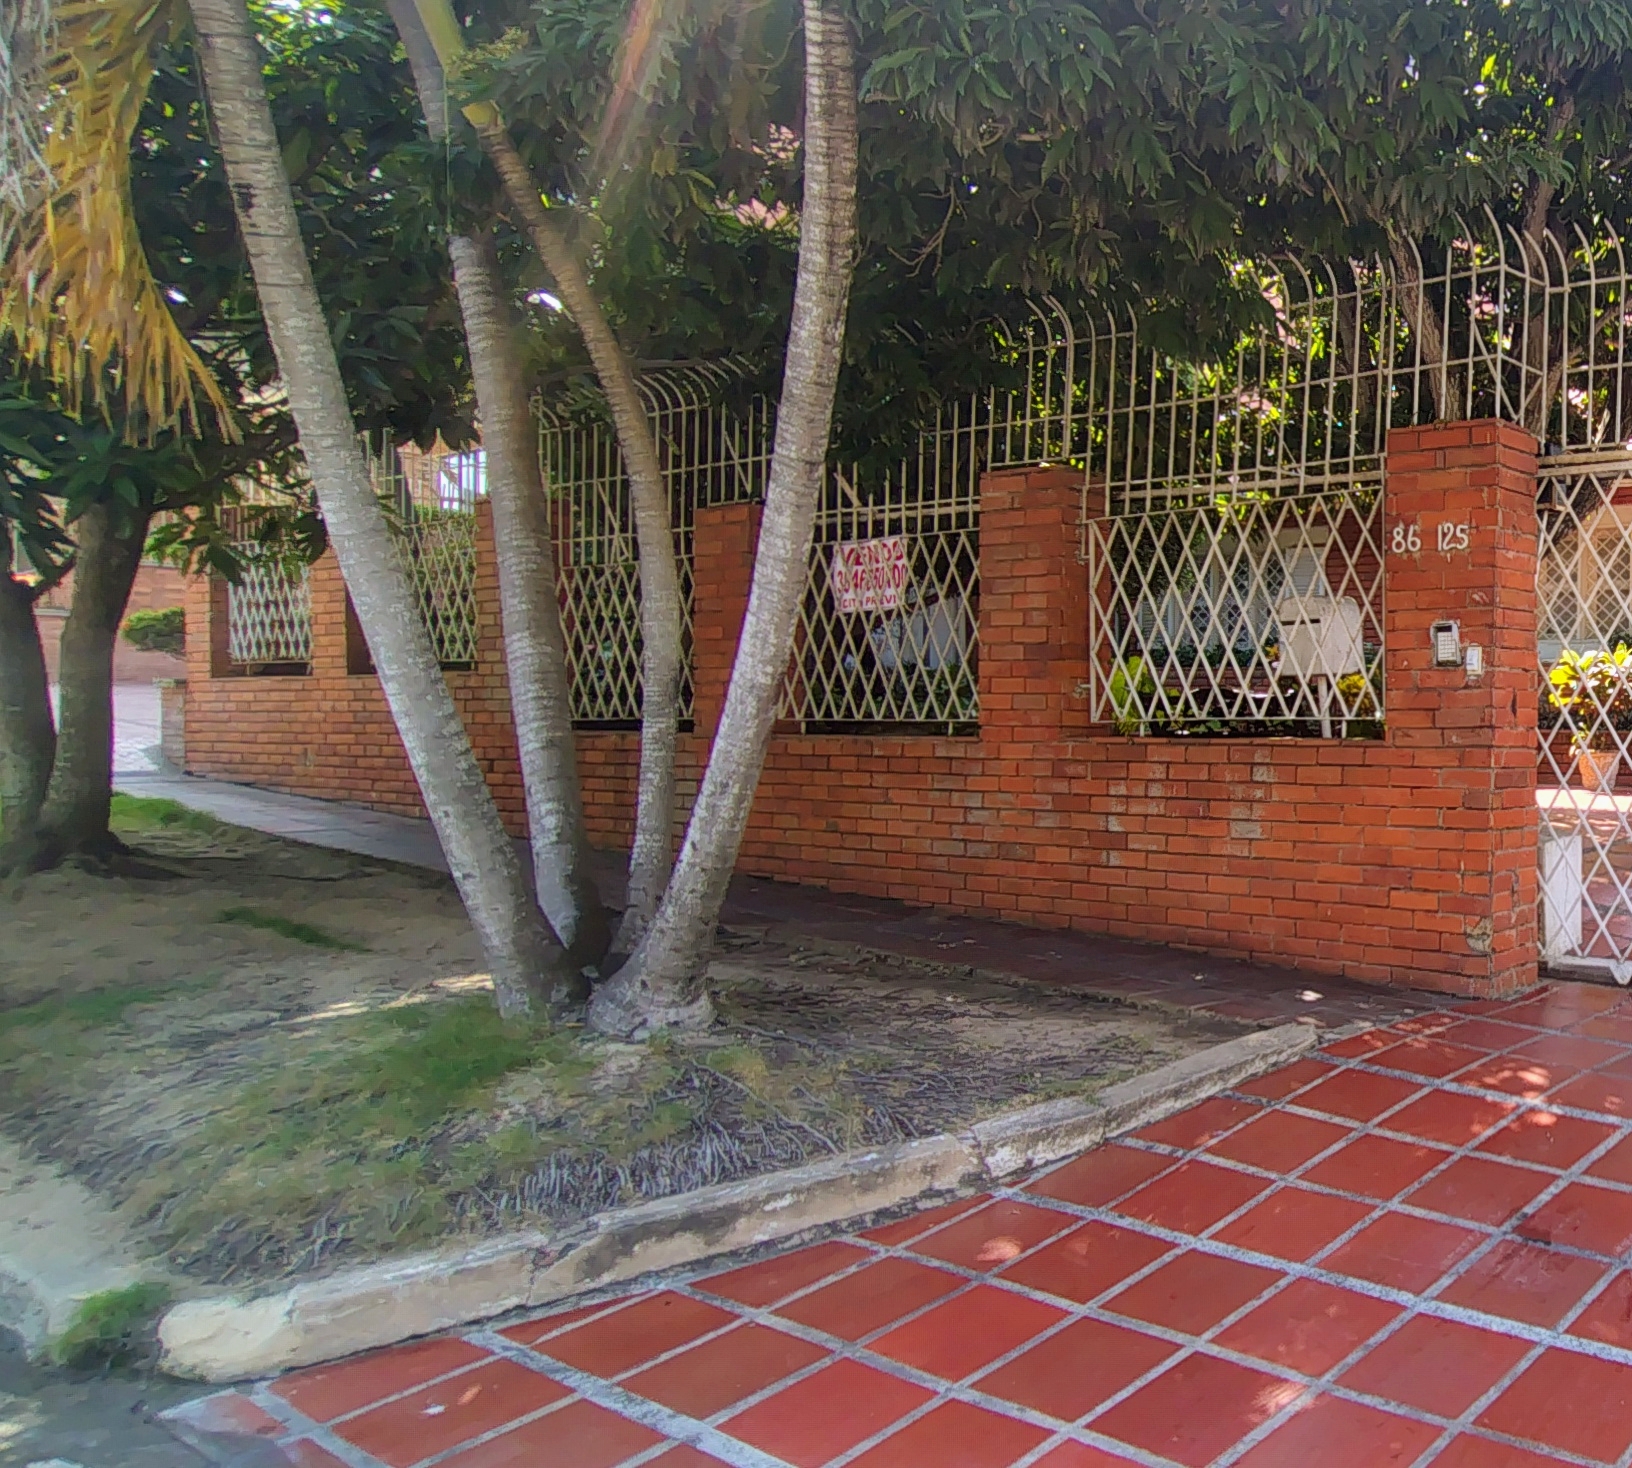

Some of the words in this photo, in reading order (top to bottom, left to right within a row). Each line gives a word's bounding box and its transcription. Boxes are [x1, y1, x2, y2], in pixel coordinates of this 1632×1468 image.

[1391, 524, 1422, 553] 86
[1437, 523, 1469, 551] 125
[840, 540, 905, 566] VENDO
[865, 594, 899, 607] PRVI
